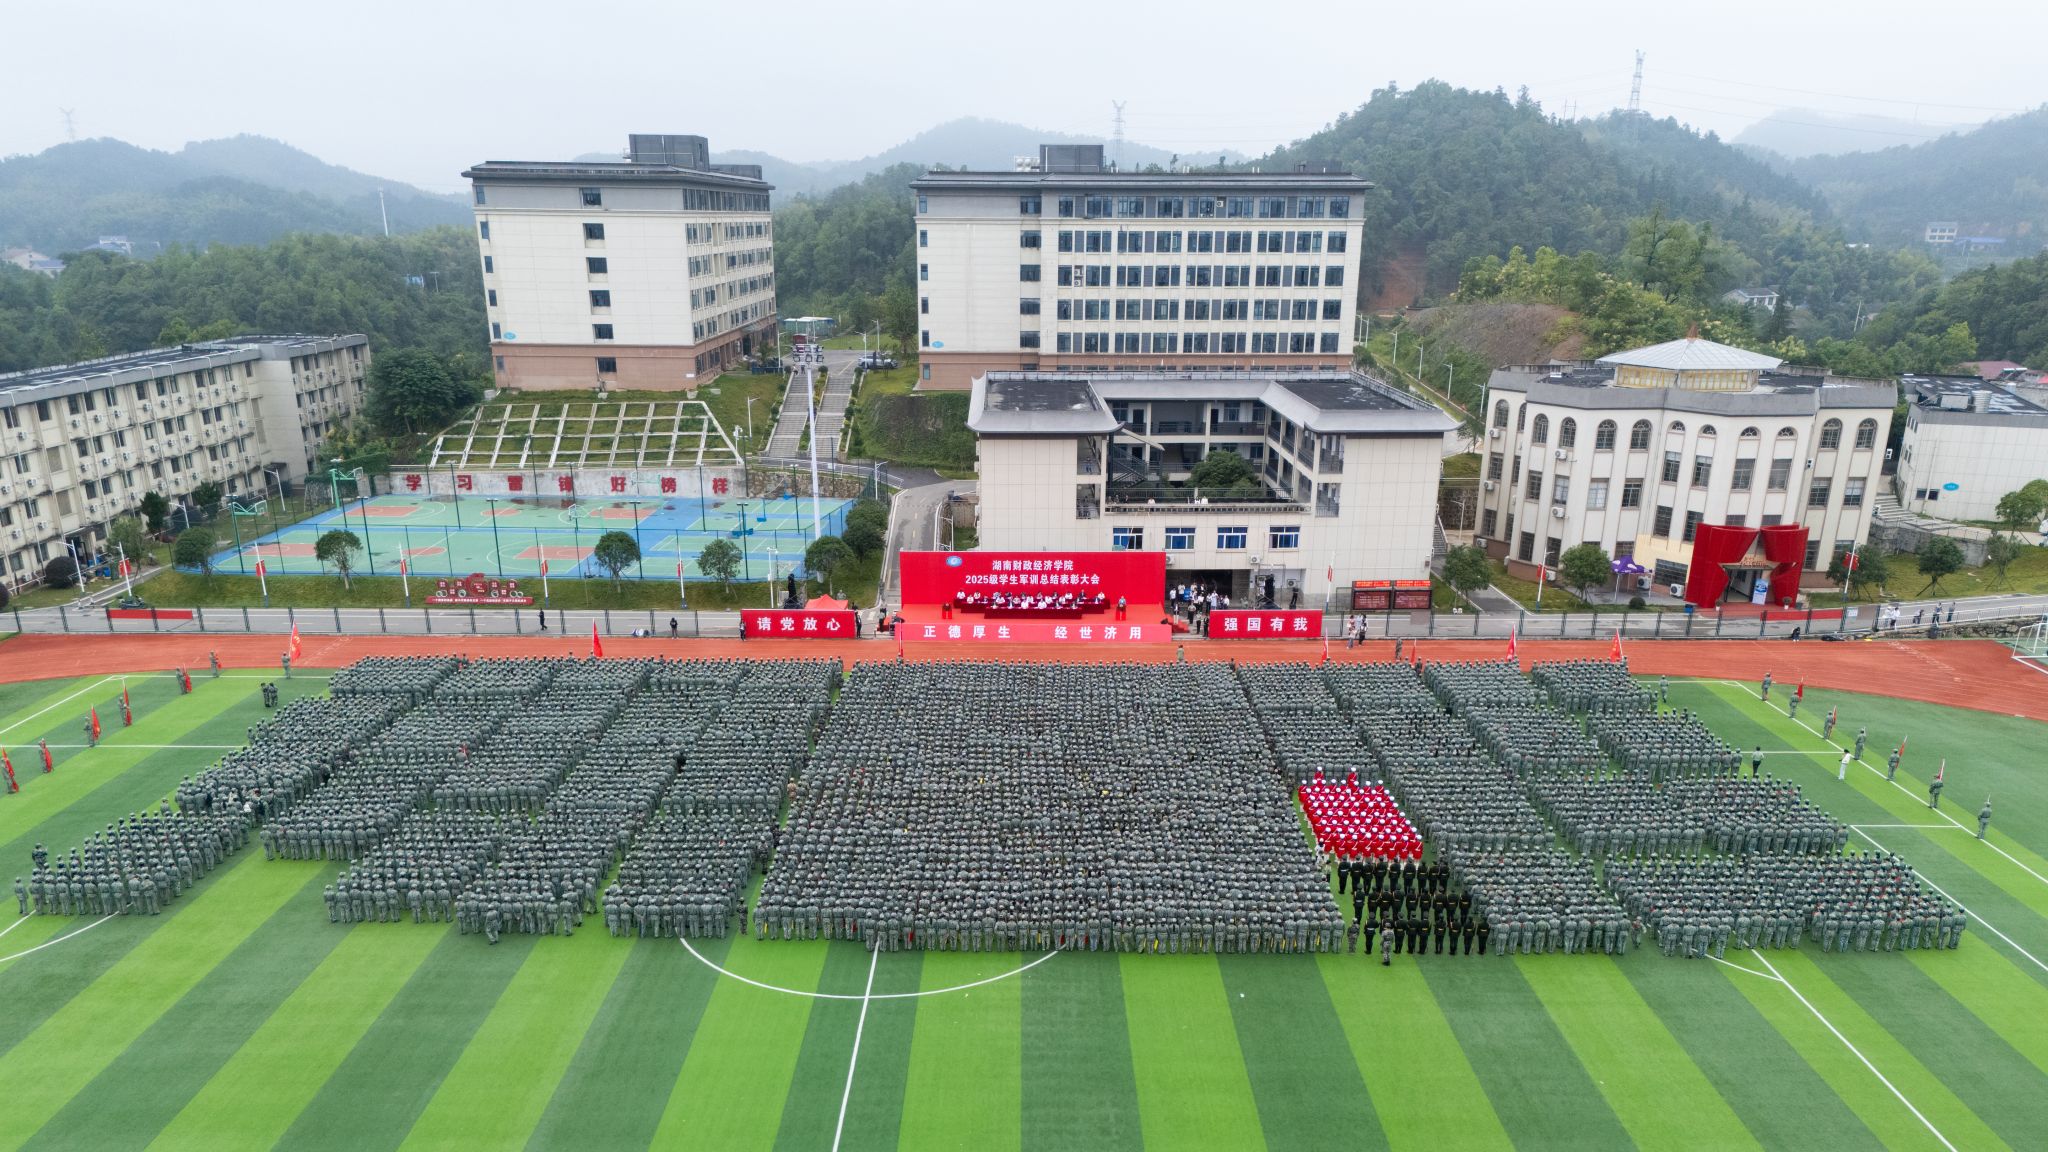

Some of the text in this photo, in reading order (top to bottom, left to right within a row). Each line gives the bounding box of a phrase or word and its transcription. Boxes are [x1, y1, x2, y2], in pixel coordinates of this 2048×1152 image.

[992, 559, 1074, 571] 湖南财政经济学院
[965, 574, 1100, 585] 2025级学生军训总结表彰大会
[757, 617, 841, 631] 请党放心
[1224, 617, 1308, 631] 强国有我
[923, 625, 1142, 639] 正德厚生 经世济用
